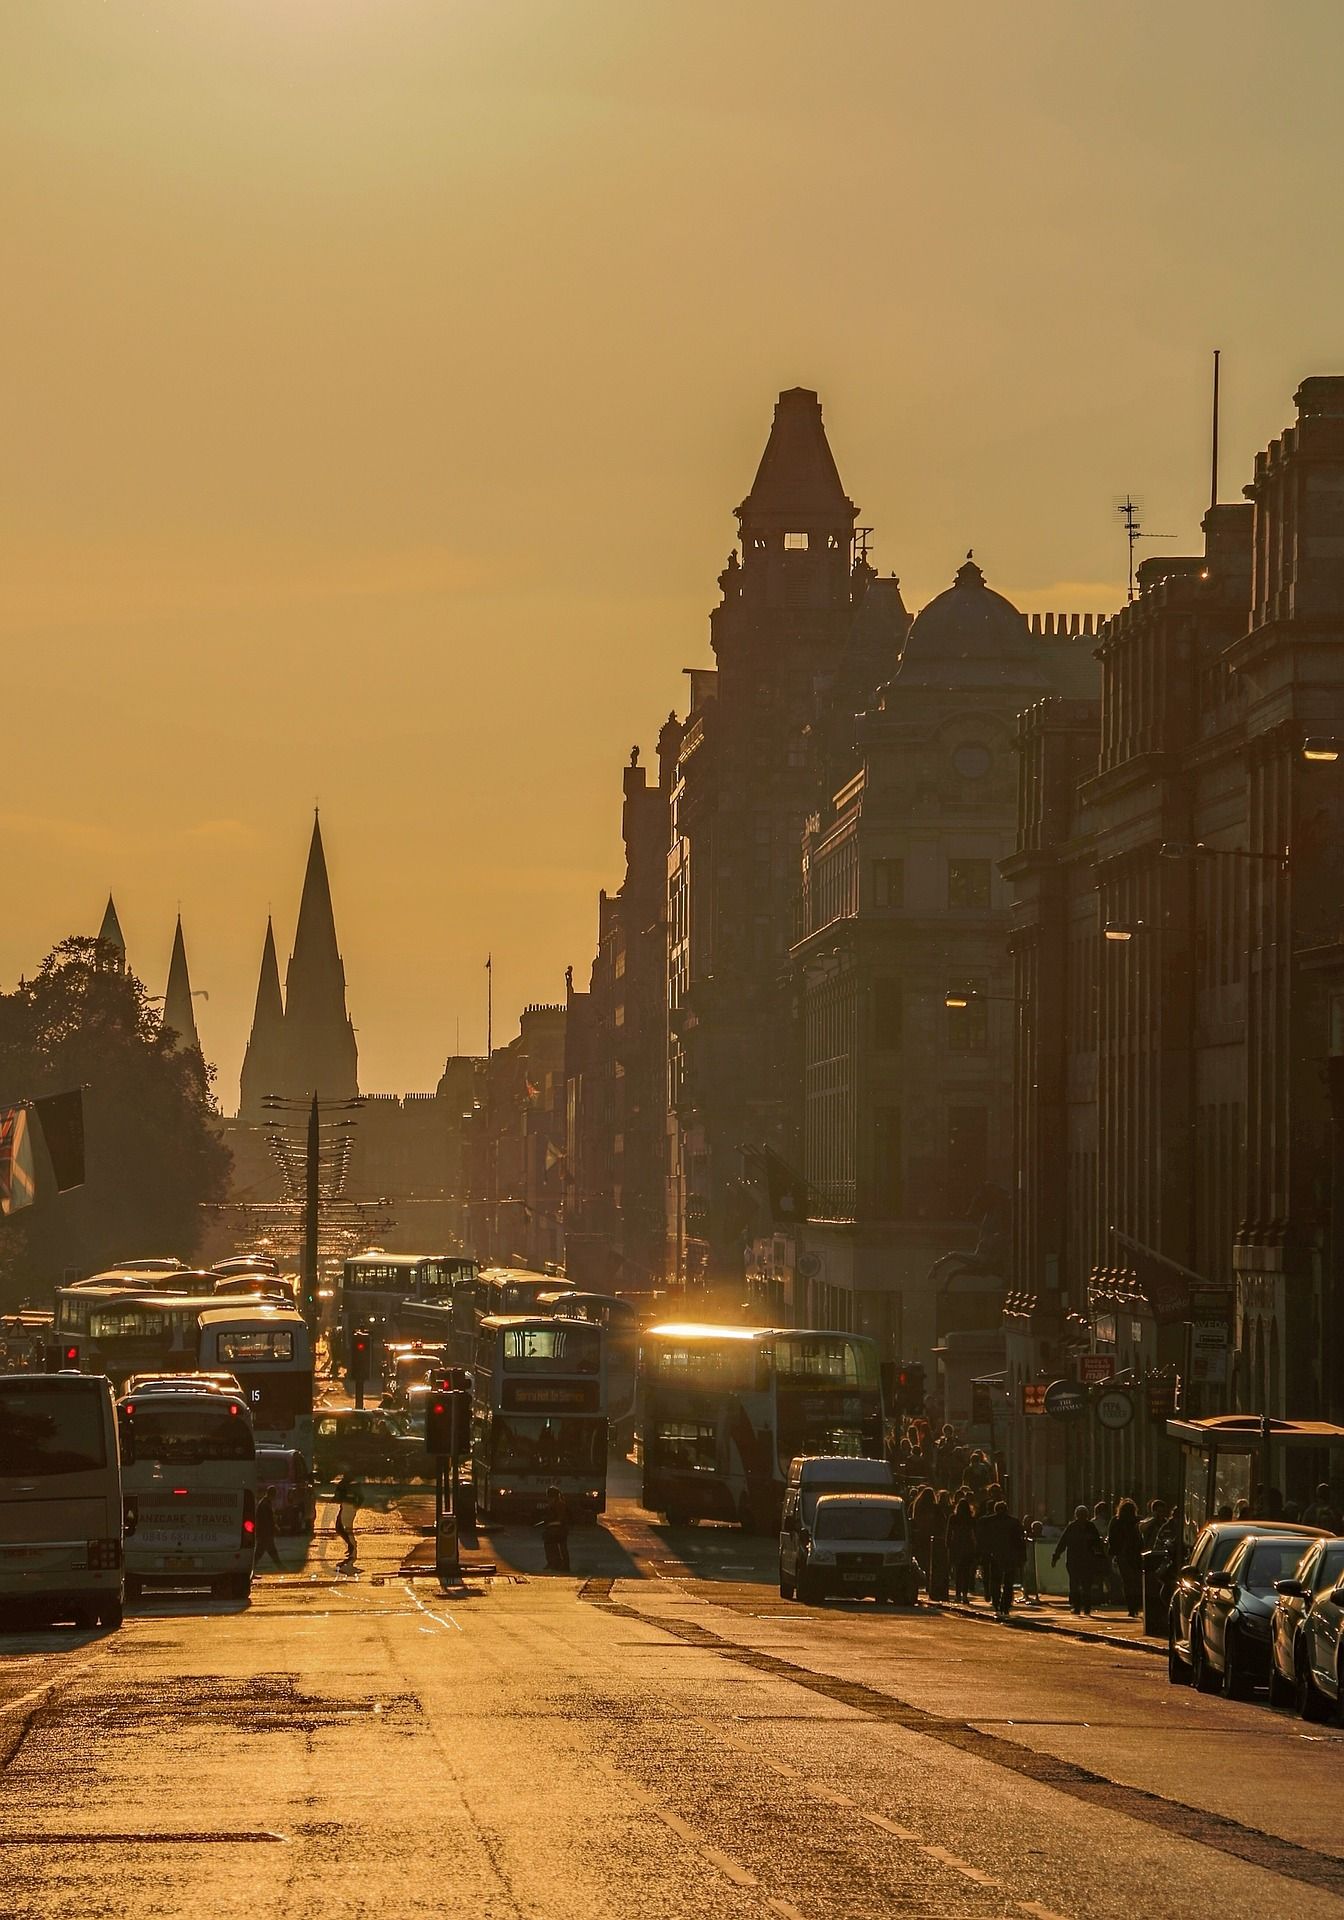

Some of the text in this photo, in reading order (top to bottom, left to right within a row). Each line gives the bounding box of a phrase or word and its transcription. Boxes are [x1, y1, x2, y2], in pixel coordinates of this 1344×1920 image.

[1195, 1320, 1229, 1329] AVEDA
[251, 1389, 260, 1401] 15
[843, 1398, 862, 1410] 22
[1060, 1399, 1071, 1407] THE
[196, 1514, 232, 1524] TRAVEL
